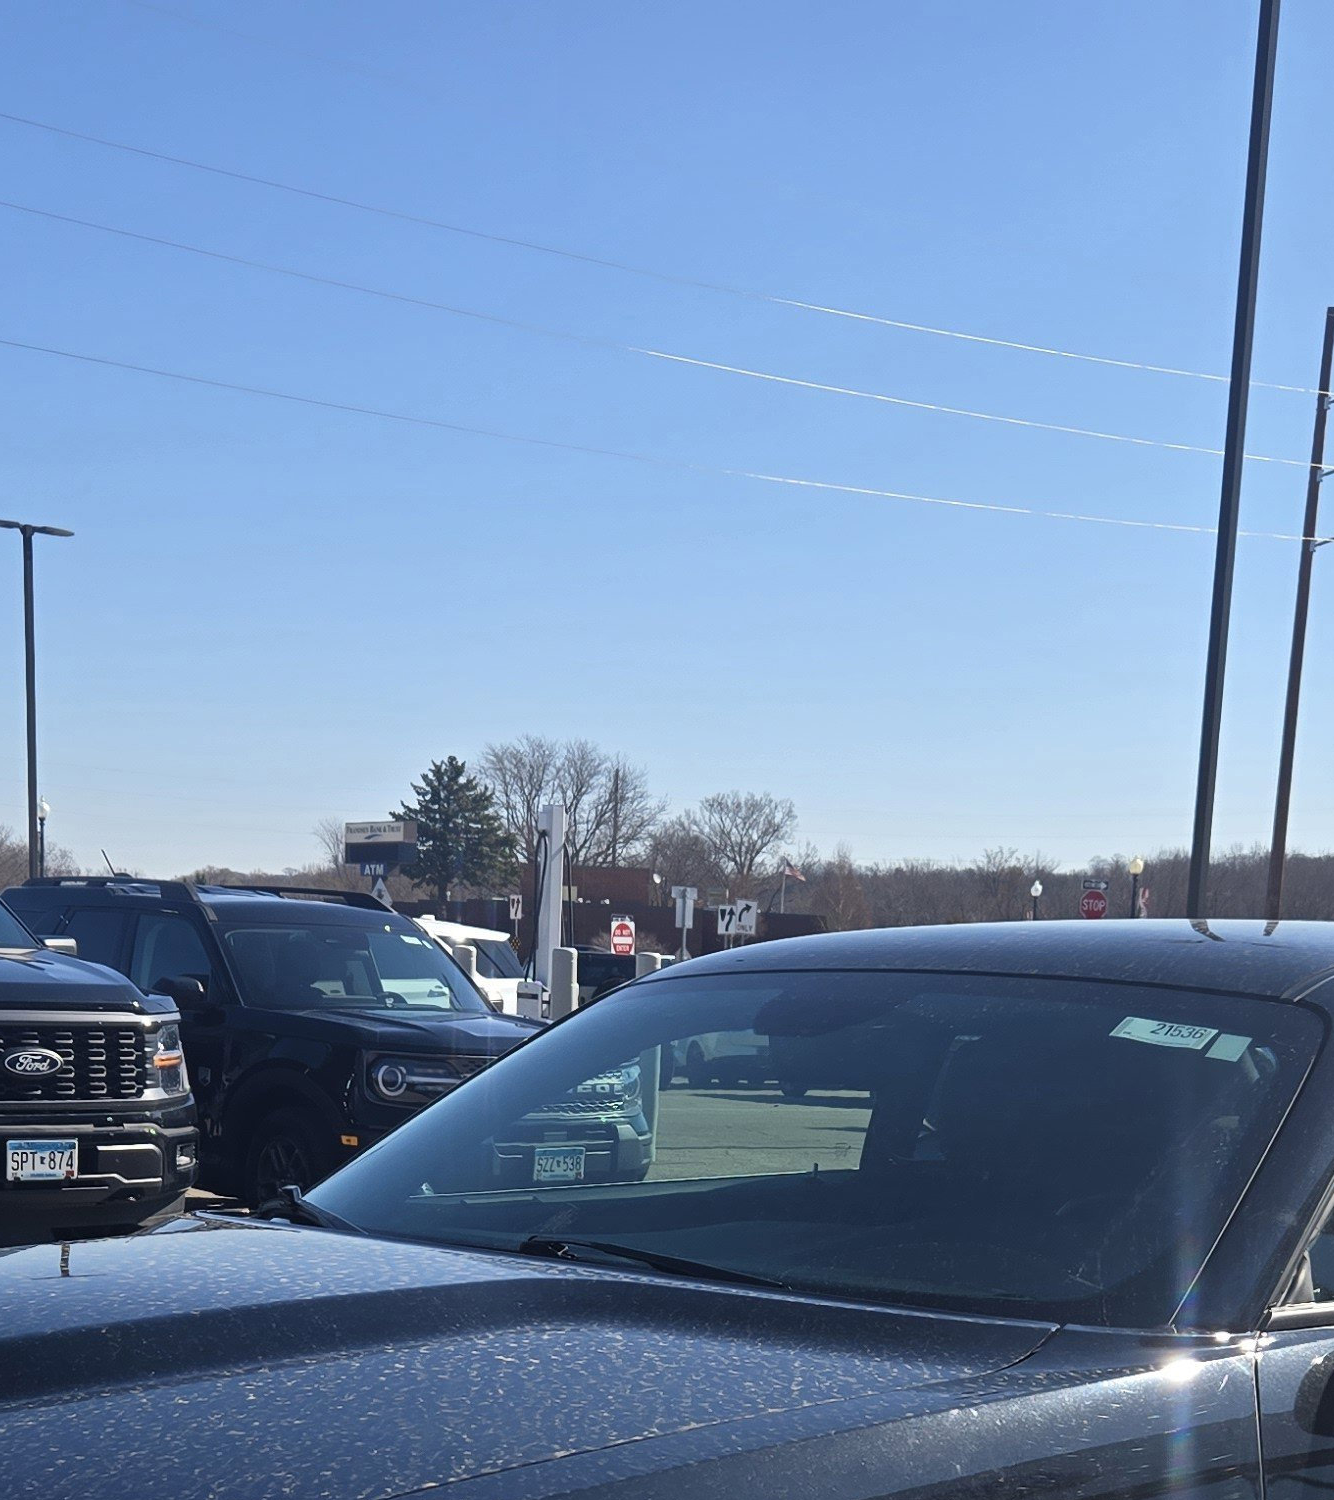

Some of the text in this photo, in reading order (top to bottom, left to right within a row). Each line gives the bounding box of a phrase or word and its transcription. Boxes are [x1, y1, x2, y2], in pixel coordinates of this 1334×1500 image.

[364, 864, 384, 875] ATM
[1082, 899, 1105, 911] STOP
[737, 924, 753, 932] ONLY
[1150, 1023, 1207, 1040] 21536
[15, 1054, 50, 1071] Ford
[11, 1151, 74, 1171] SPT 874
[536, 1155, 582, 1173] SZZ 538
